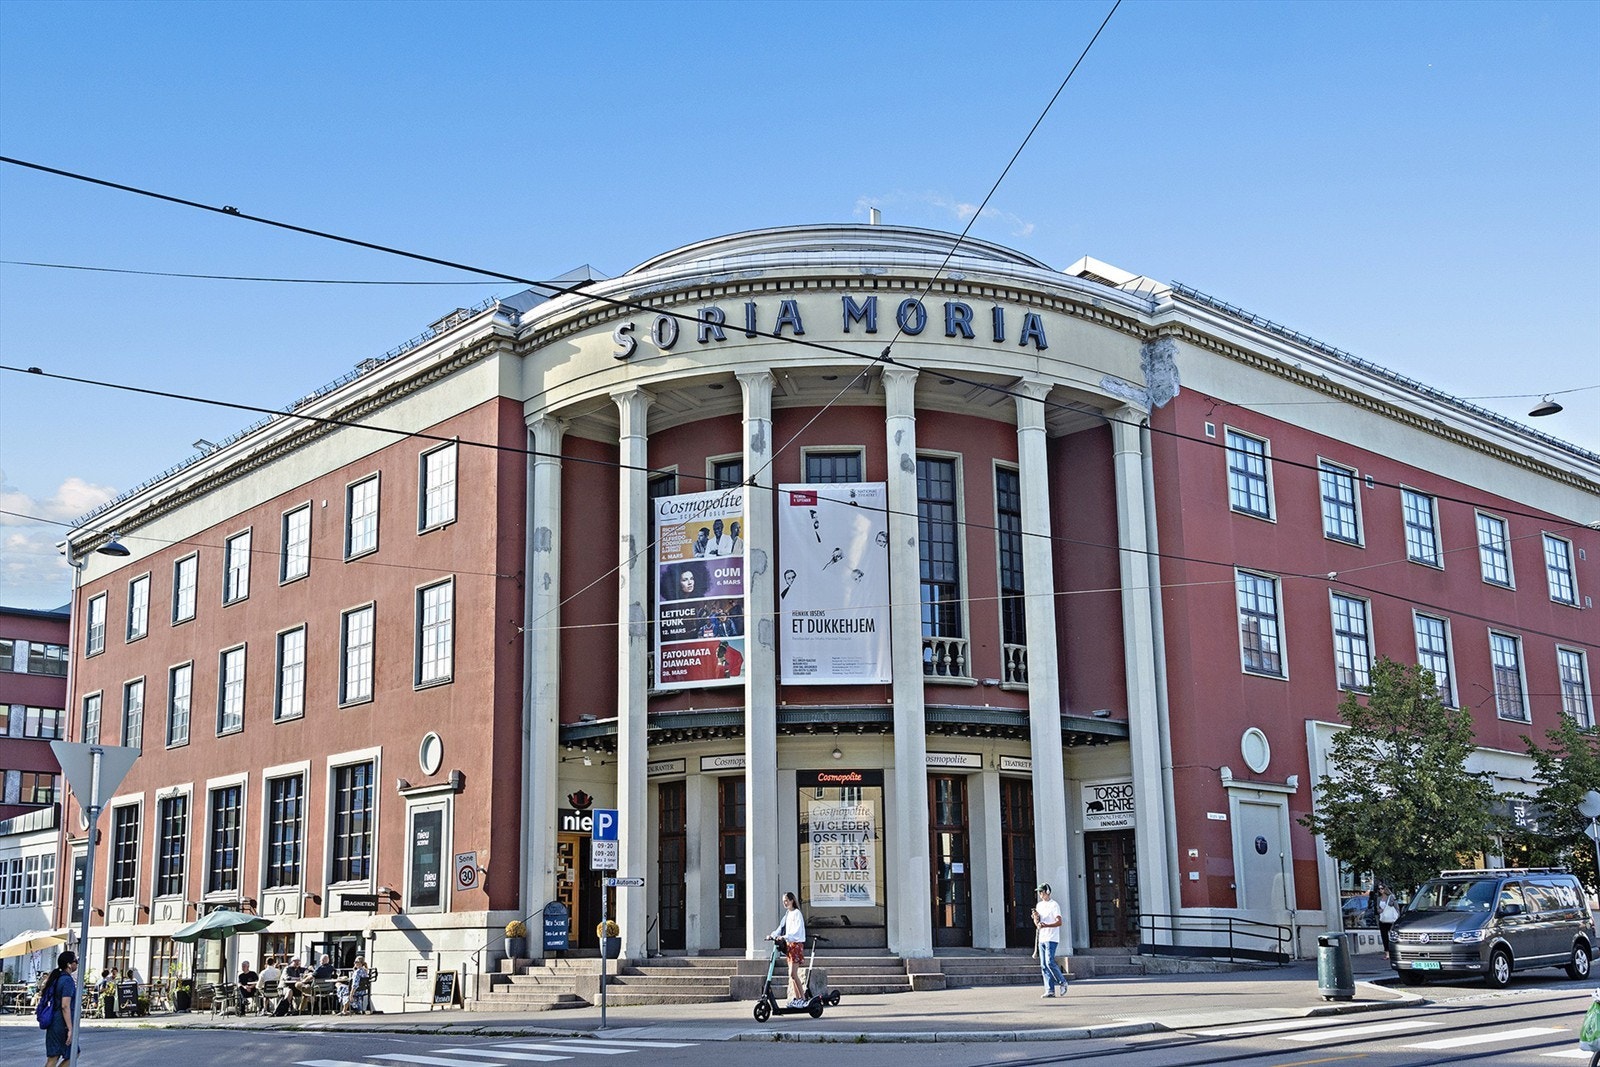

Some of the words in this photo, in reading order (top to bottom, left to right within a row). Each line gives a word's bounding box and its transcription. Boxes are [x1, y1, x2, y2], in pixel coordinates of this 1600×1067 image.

[613, 300, 805, 360] SORIA
[841, 295, 1049, 351] MORIA
[660, 491, 742, 517] Cosmopolite
[714, 568, 741, 578] OUM
[661, 608, 695, 618] LETTUCE
[661, 618, 684, 627] FUNK
[792, 619, 804, 633] ET
[807, 618, 875, 633] DUKKEHJEM
[662, 648, 711, 659] FATOUMATA
[662, 658, 702, 668] DIAWARA
[926, 755, 968, 765] osmopolite
[817, 772, 862, 784] Cosmopolite
[1094, 785, 1134, 799] TORSHO
[1102, 797, 1135, 811] TEATRE
[812, 805, 871, 818] Cosmopolite
[563, 810, 592, 831] nie
[599, 813, 613, 837] P
[813, 821, 824, 830] VI
[827, 821, 870, 830] GLEDER
[416, 829, 429, 839] nieu
[813, 833, 838, 842] OSS
[840, 833, 856, 842] TIL
[862, 831, 870, 842] Å
[819, 845, 832, 855] SE
[836, 845, 866, 855] DERE
[423, 871, 437, 881] nieu
[461, 870, 473, 881] 30
[815, 871, 841, 880] MED
[844, 871, 870, 880] MER
[819, 884, 866, 893] MUSIKK
